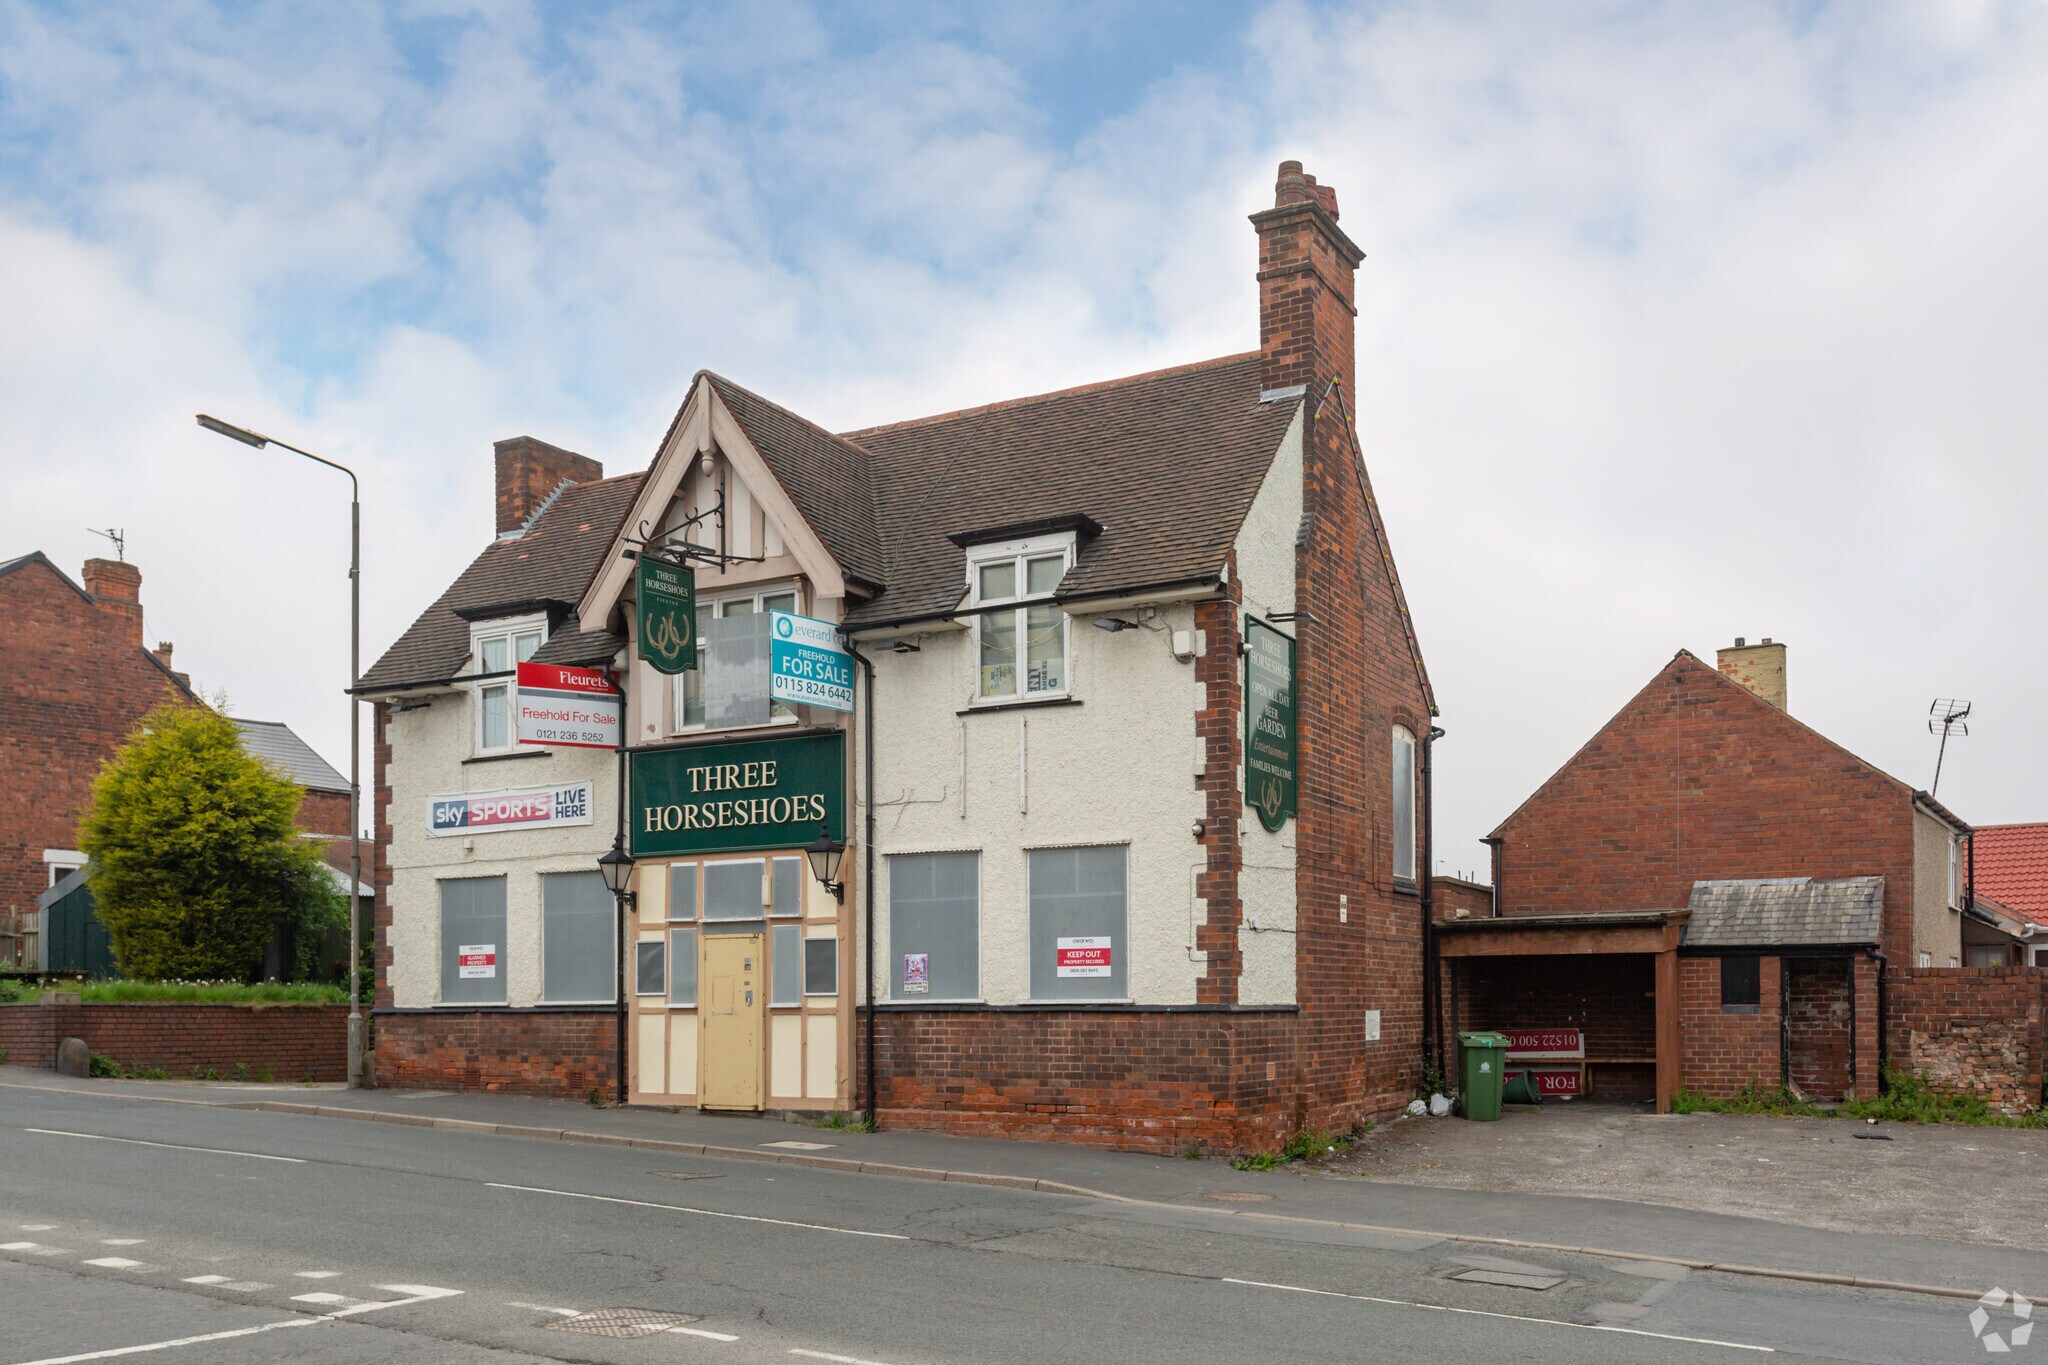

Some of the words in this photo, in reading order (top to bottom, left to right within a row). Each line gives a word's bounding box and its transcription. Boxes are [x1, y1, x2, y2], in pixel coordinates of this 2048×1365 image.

[656, 570, 678, 584] THREE
[645, 579, 689, 597] HORSESHOES
[795, 626, 831, 642] everard
[833, 634, 844, 645] co
[1261, 636, 1282, 658] THREE
[798, 649, 836, 664] FREEHOLD
[782, 656, 813, 677] FOR
[815, 663, 849, 685] SALE
[1250, 650, 1292, 682] HORSESHOES
[559, 671, 609, 688] Fleurets
[775, 676, 803, 692] 0115
[806, 682, 826, 697] 824
[827, 686, 852, 703] 6442
[1252, 681, 1267, 697] OPEN
[1267, 689, 1278, 703] ALL
[1278, 693, 1291, 708] DAY
[522, 708, 570, 721] Freehold
[572, 711, 590, 723] For
[593, 713, 616, 725] Sale
[1264, 705, 1279, 720] BEER
[536, 729, 556, 739] 0121
[560, 731, 578, 741] 236
[582, 732, 604, 742] 5252
[1256, 714, 1287, 739] GARDEN
[1254, 737, 1289, 761] Entertainment
[686, 760, 778, 793] THREE
[1250, 757, 1271, 773] FAMILIES
[1271, 764, 1293, 781] WELCOME
[555, 788, 586, 805] LIVE
[435, 801, 464, 827] sky
[471, 797, 548, 822] SPORTS
[555, 804, 586, 819] HERE
[644, 794, 826, 833] HORSESHOES
[1519, 1035, 1539, 1047] 500
[1542, 1034, 1577, 1047] 01522
[1544, 1076, 1577, 1089] FOR
